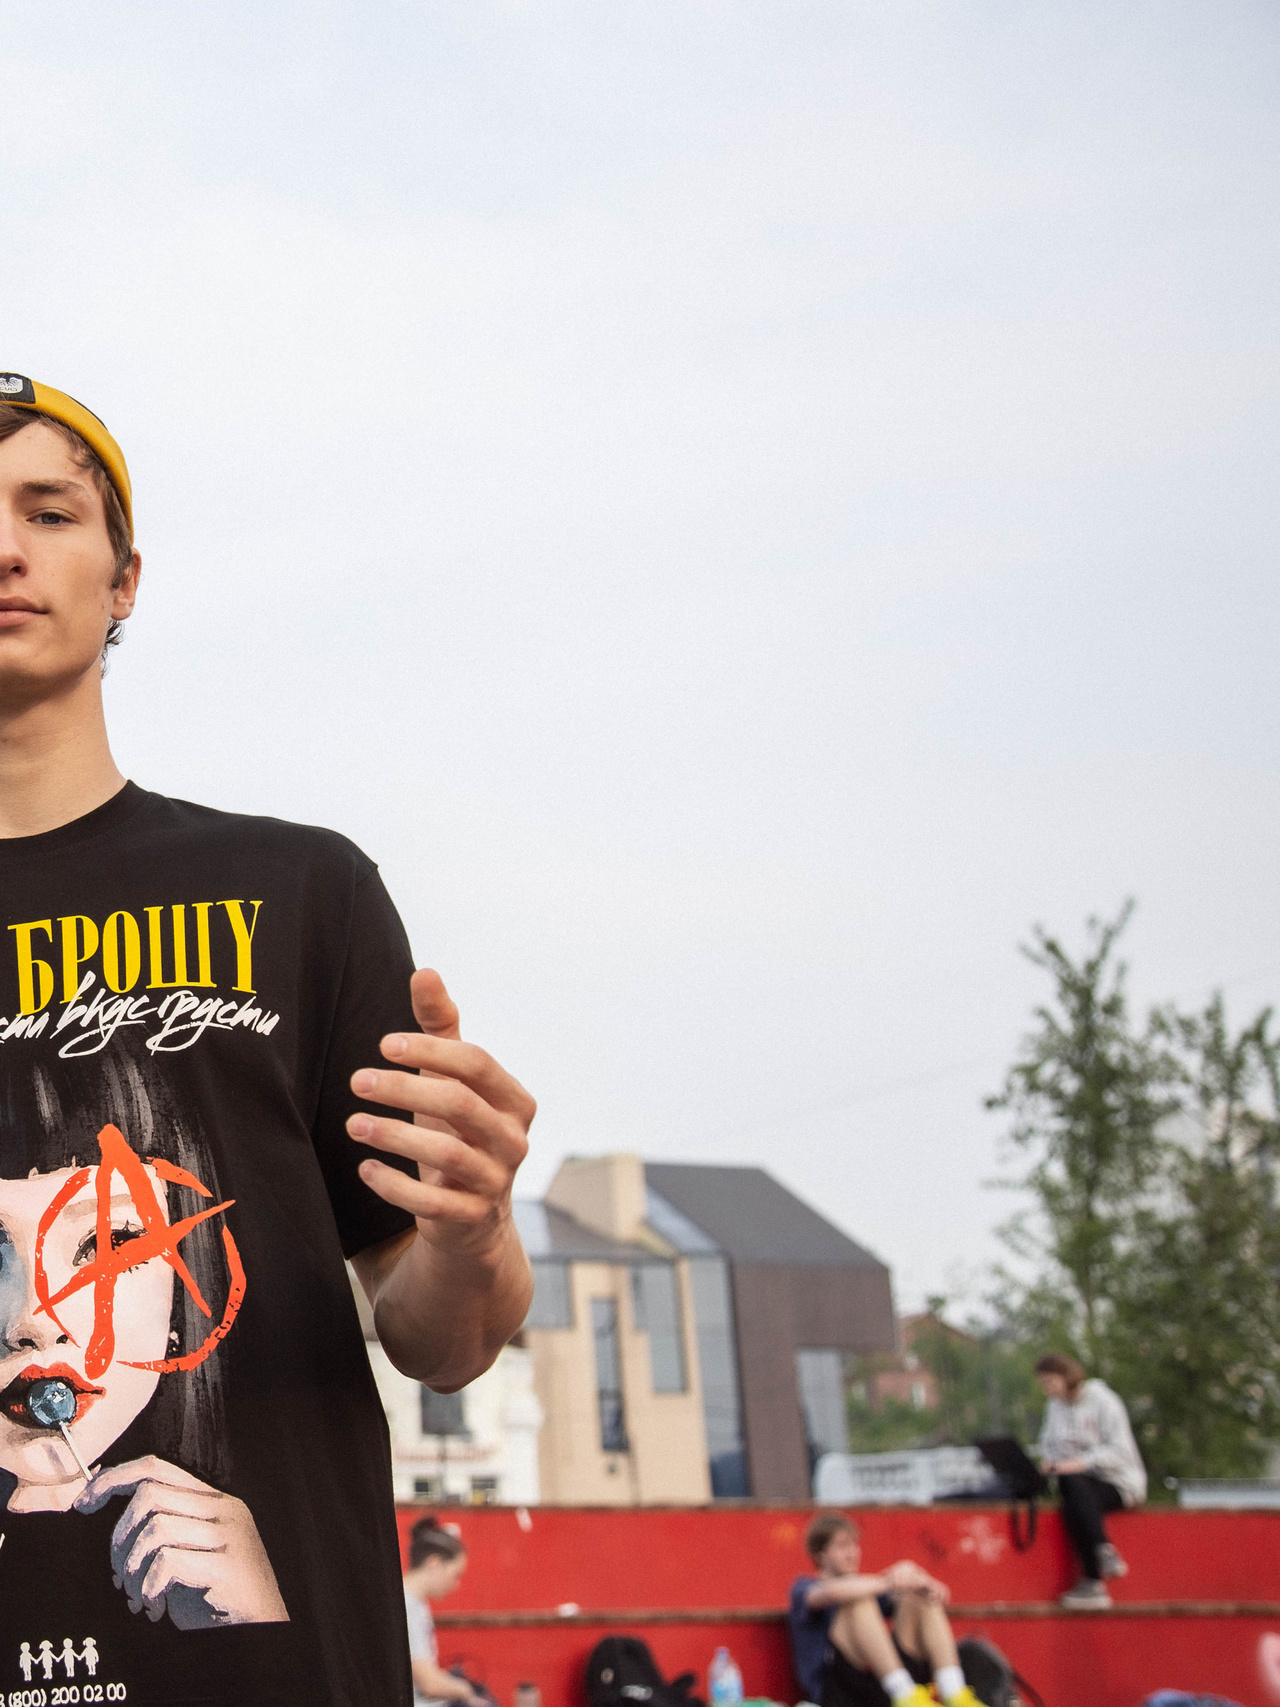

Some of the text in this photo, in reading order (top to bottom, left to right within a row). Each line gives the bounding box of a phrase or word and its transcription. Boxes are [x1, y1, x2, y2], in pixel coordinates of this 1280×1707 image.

[7, 899, 263, 1017] БРОШУ
[7, 1688, 48, 1707] (800)
[51, 1686, 81, 1706] 200
[83, 1684, 105, 1703] 02
[106, 1683, 127, 1702] 00
